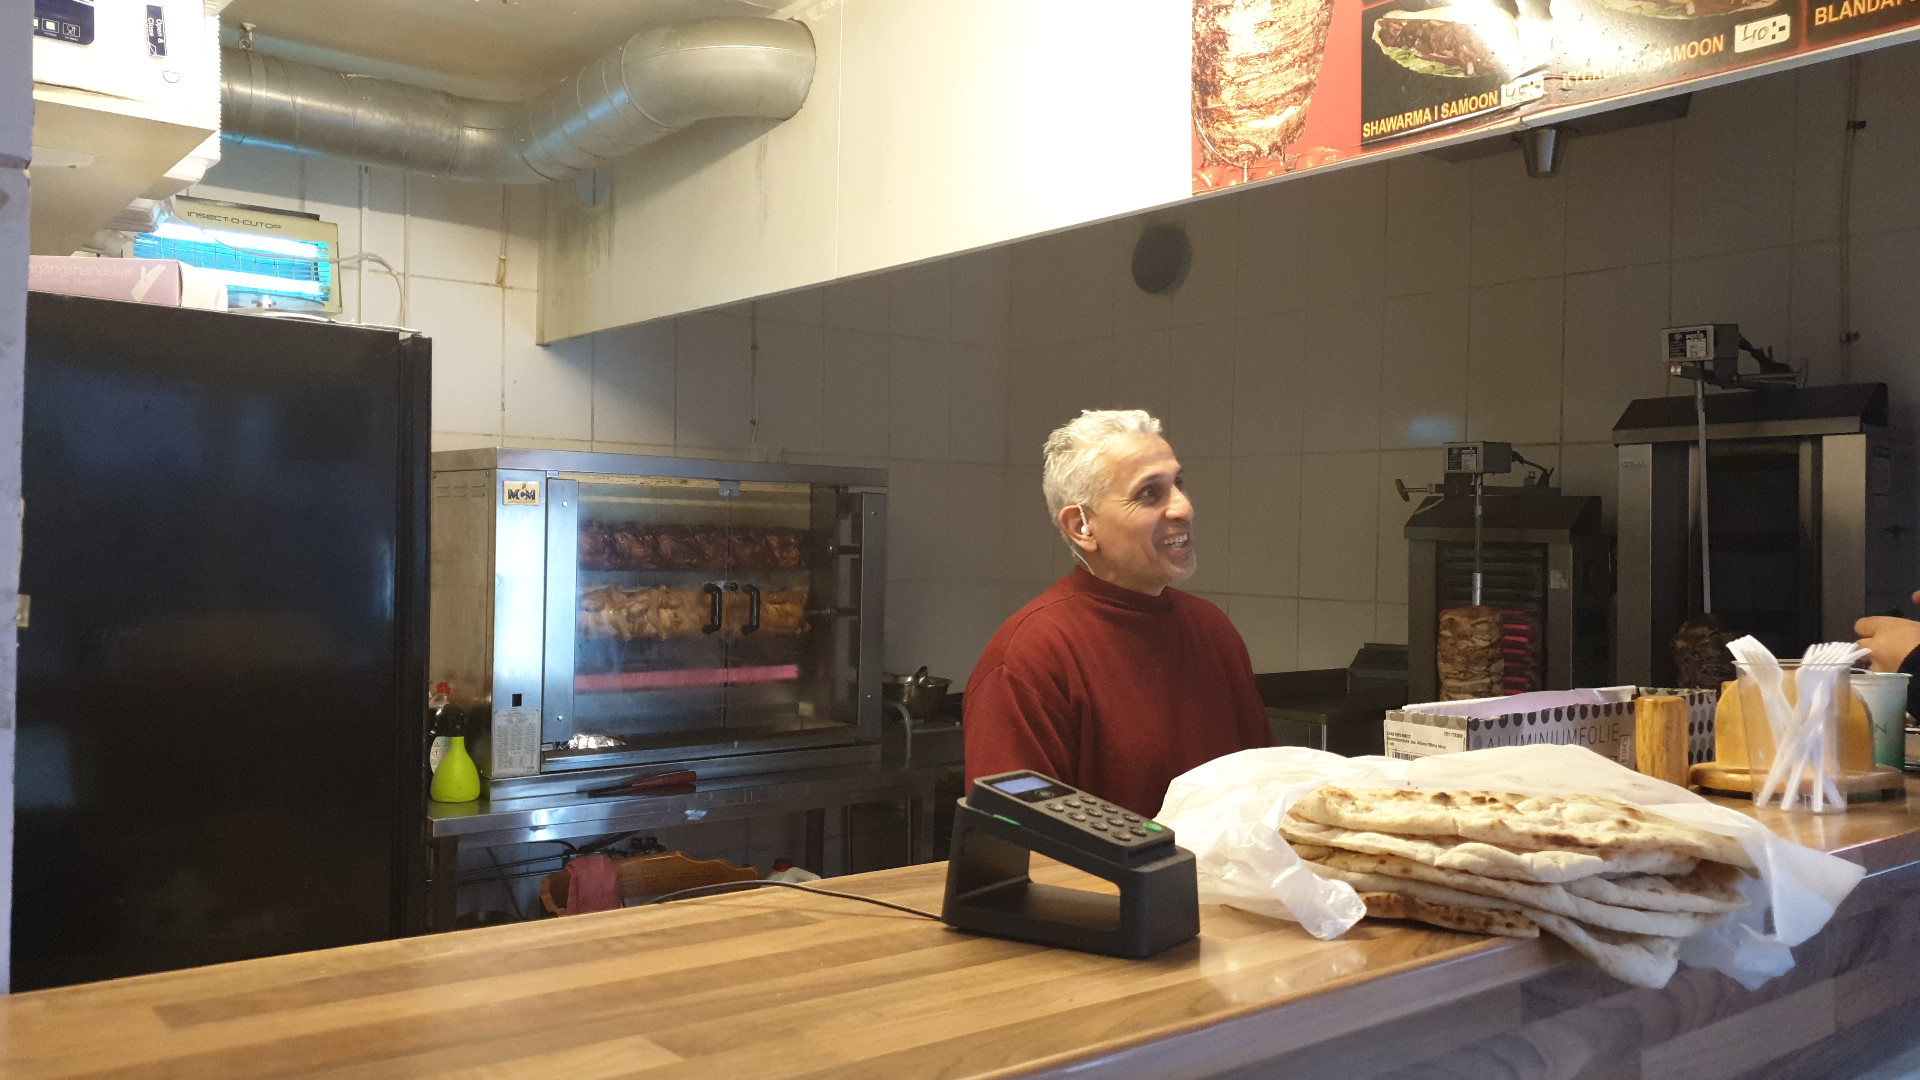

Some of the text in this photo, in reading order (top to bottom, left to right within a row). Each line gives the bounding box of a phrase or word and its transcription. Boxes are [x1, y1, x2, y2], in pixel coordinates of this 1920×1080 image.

[1815, 0, 1902, 25] BLANDA
[1650, 34, 1724, 66] SAMOON
[1363, 91, 1498, 138] SHAWARMA I SAMOON
